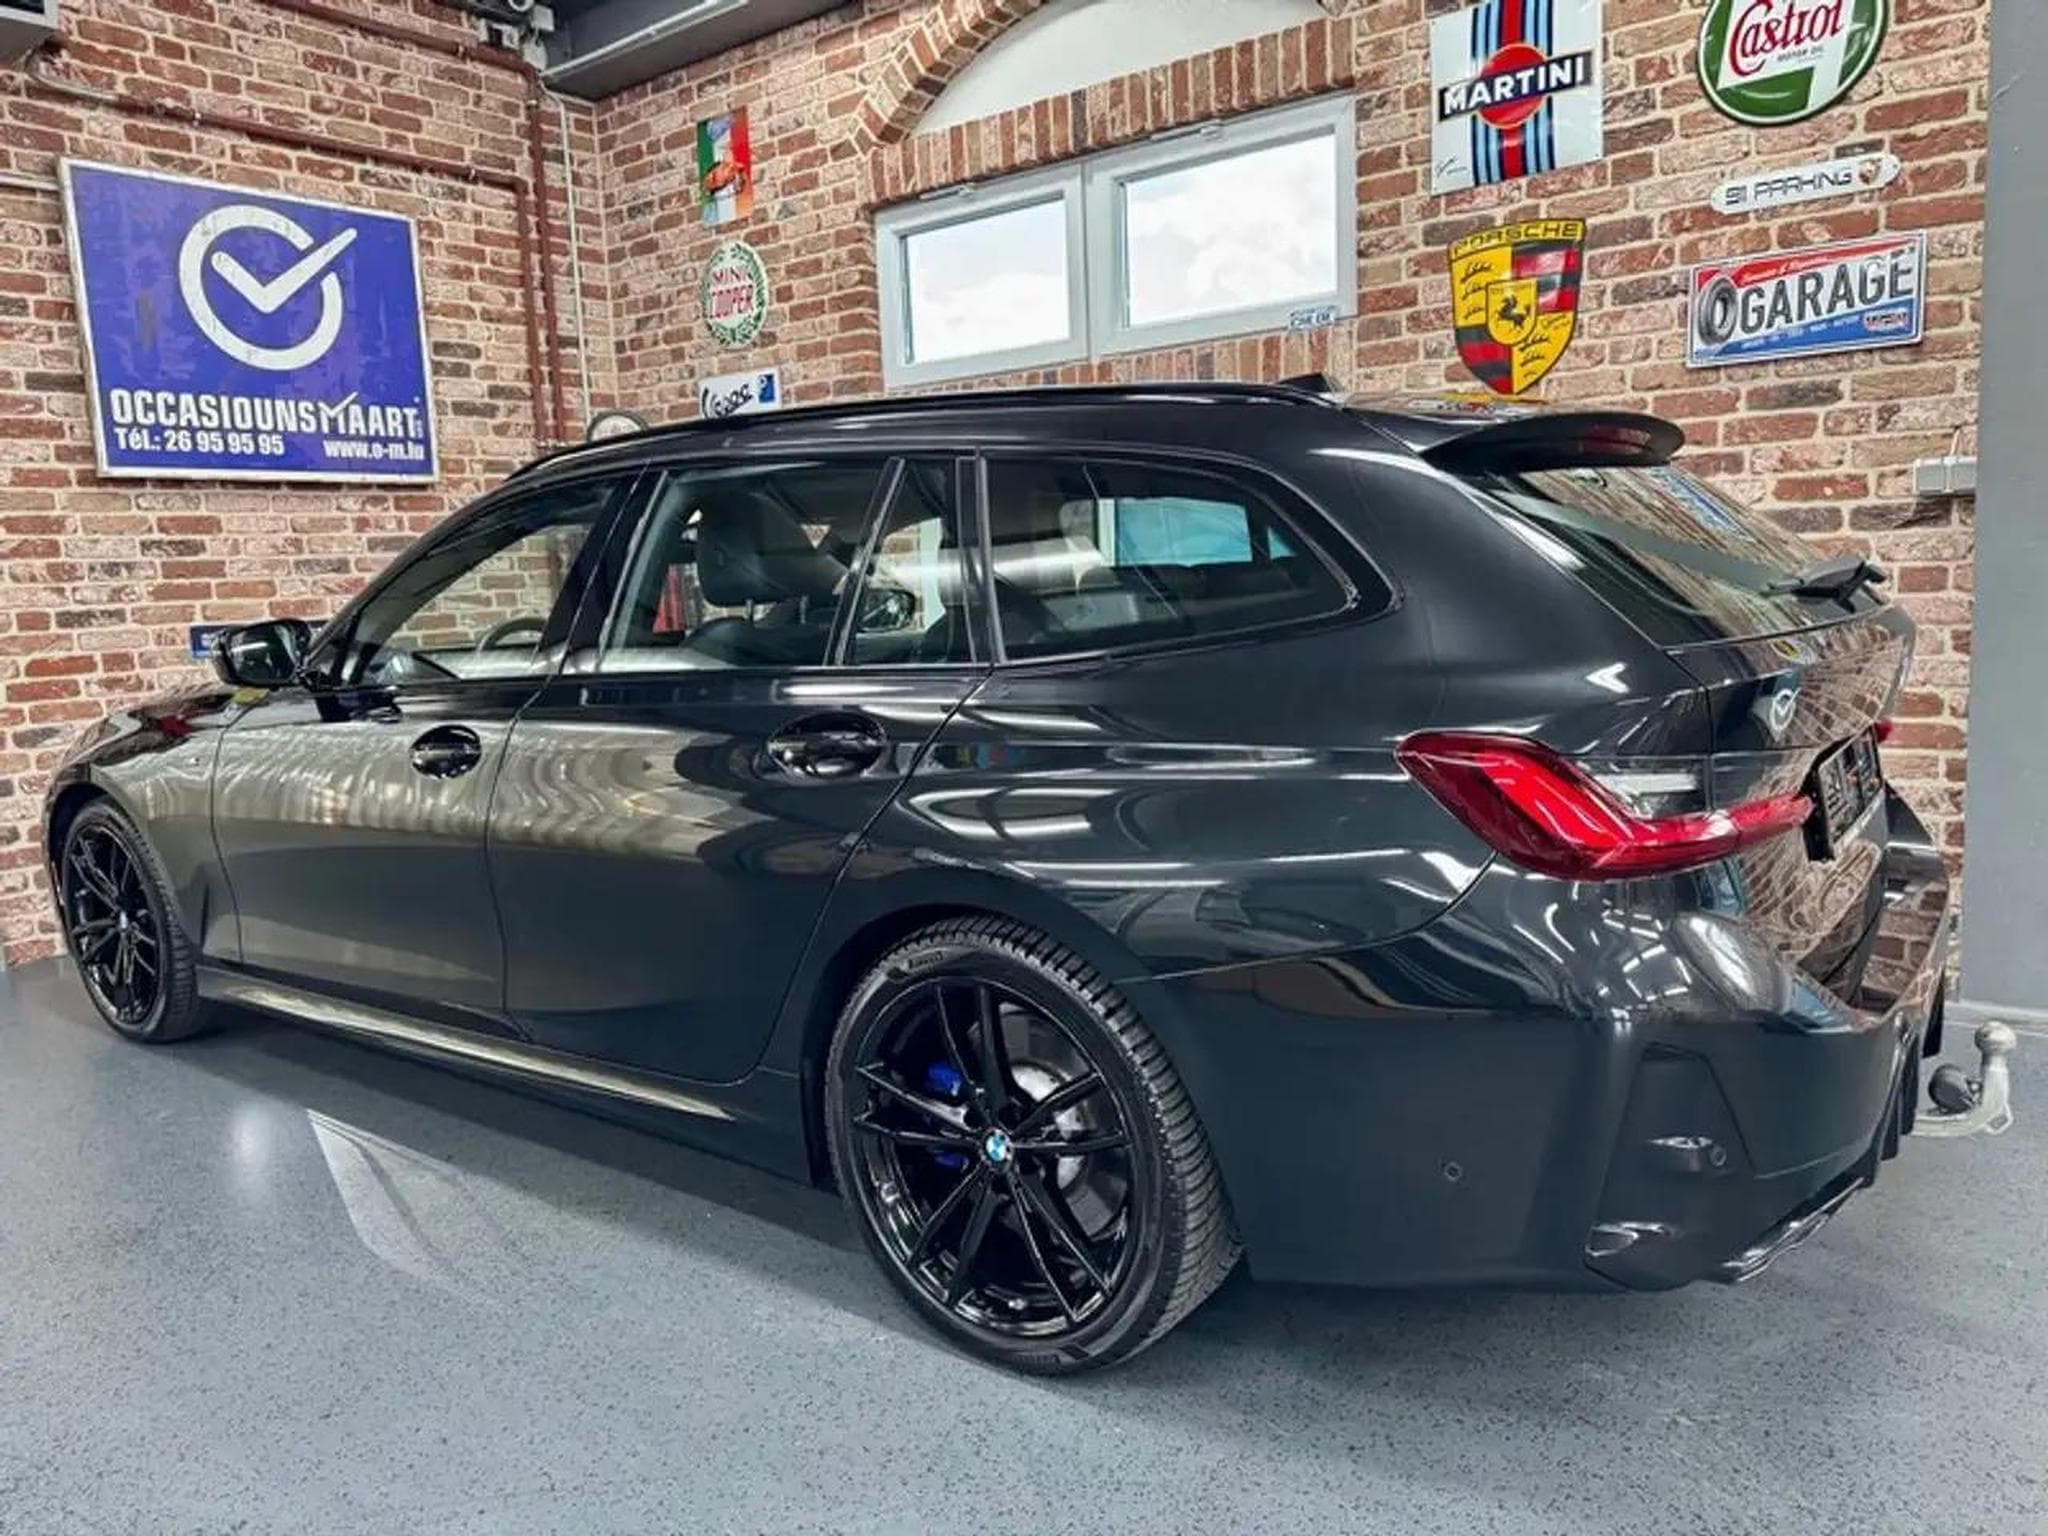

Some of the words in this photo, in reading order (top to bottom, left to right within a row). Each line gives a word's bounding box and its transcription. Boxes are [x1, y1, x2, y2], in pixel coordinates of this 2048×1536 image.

[1728, 0, 1844, 76] Castrol
[1443, 55, 1584, 115] MARTINI
[1753, 171, 1853, 202] PARKING
[1454, 222, 1578, 257] PORSCHE
[1740, 248, 1915, 335] GARAGE
[109, 388, 419, 438] OCCASIOUNSMAART
[163, 429, 193, 453] 26
[196, 431, 224, 454] 95
[227, 432, 255, 455] 95
[258, 434, 286, 457] 95
